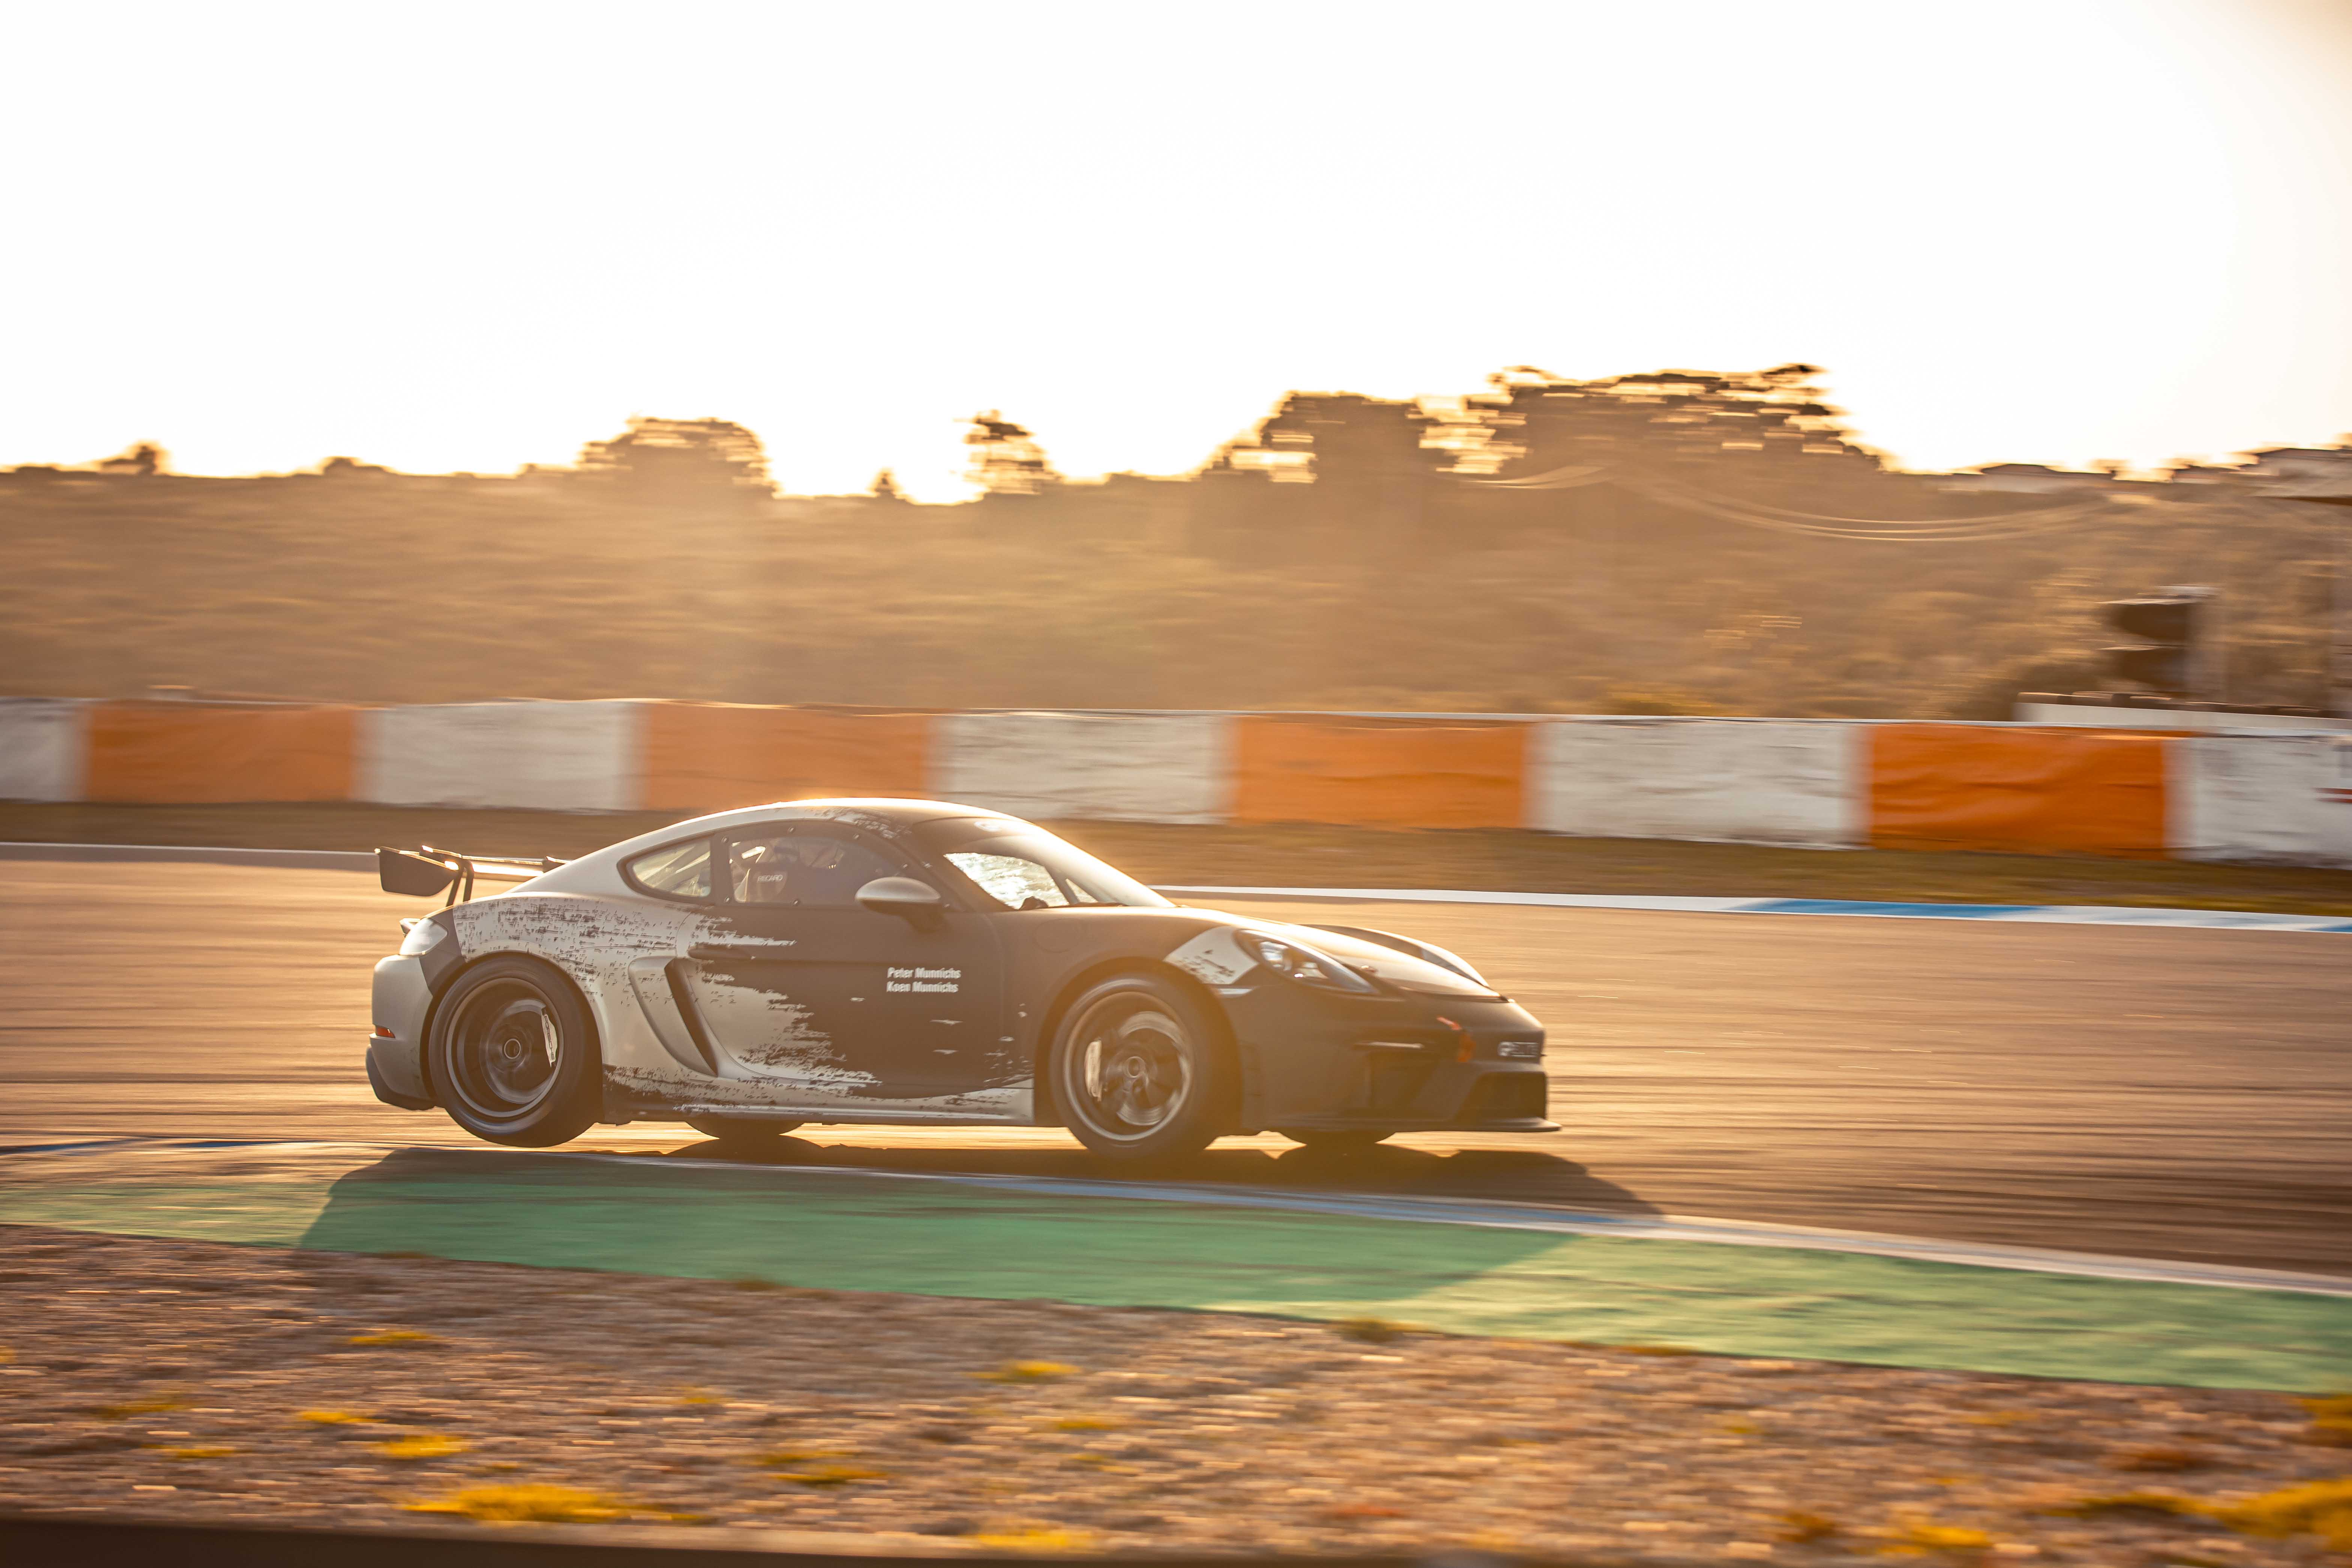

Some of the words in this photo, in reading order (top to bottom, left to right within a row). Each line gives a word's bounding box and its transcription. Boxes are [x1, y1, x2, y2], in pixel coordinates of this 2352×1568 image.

[887, 967, 914, 978] Peter
[886, 981, 911, 992] Koen
[544, 1016, 555, 1060] PORSCHE
